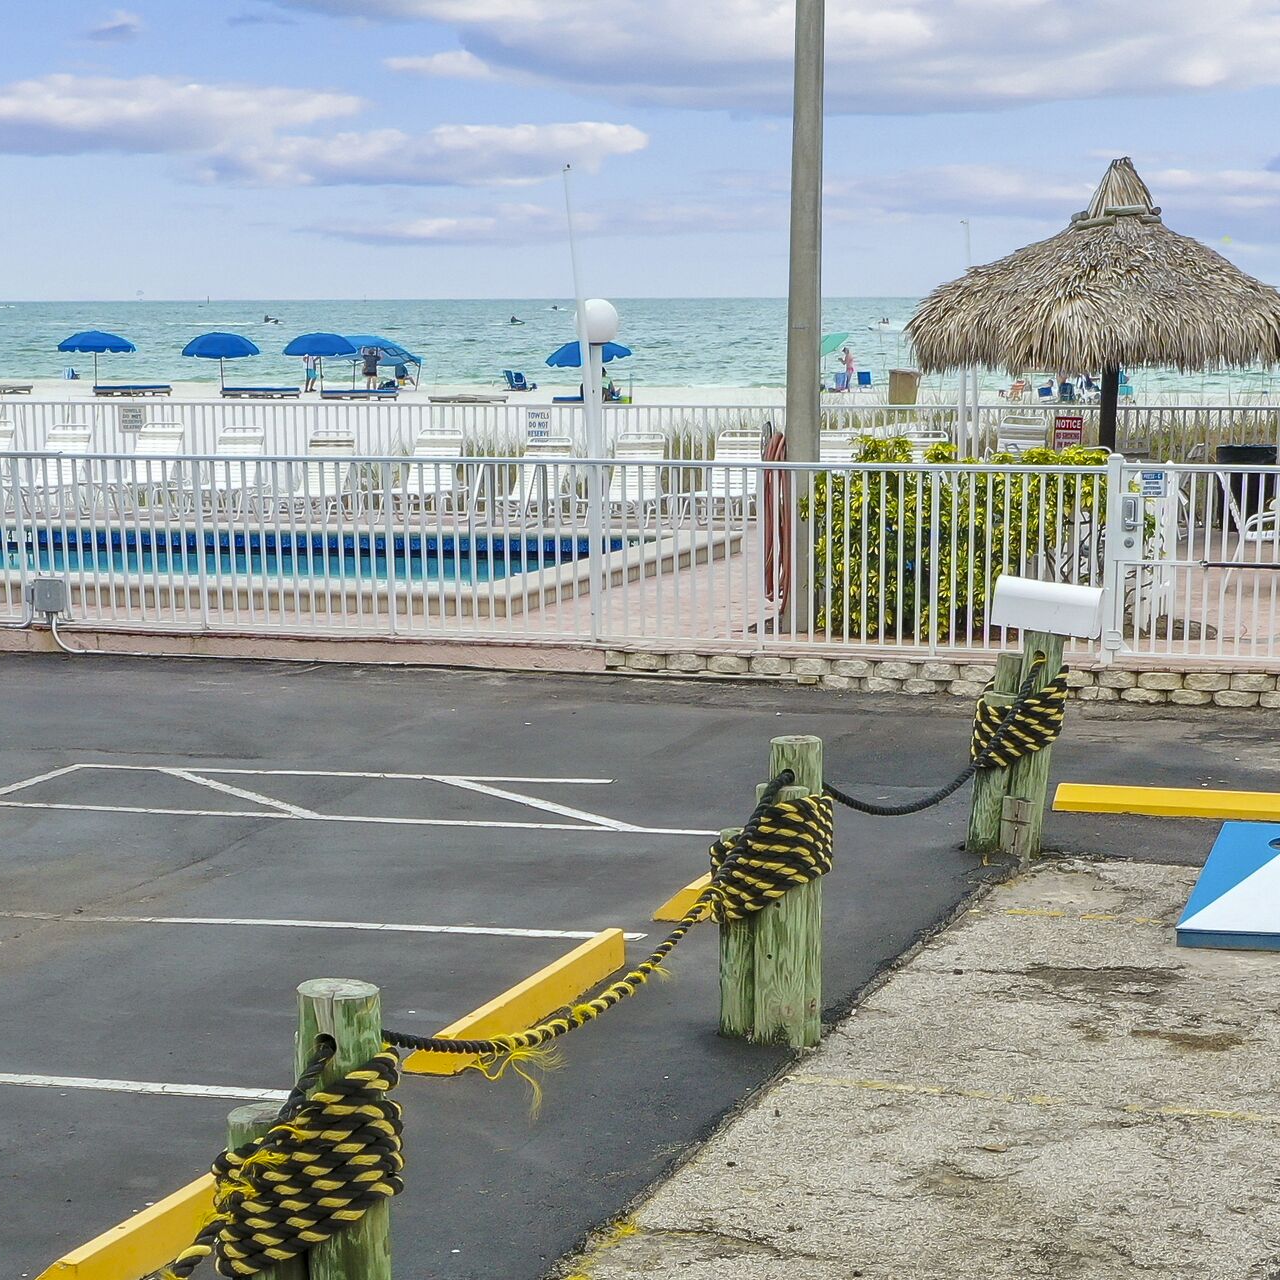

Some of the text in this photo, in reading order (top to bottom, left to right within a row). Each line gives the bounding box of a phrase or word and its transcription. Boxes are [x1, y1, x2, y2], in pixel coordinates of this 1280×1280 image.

[527, 411, 550, 420] TOWELS
[538, 421, 549, 429] NOT
[1055, 419, 1081, 429] NOTICE
[527, 430, 550, 438] RESERVE
